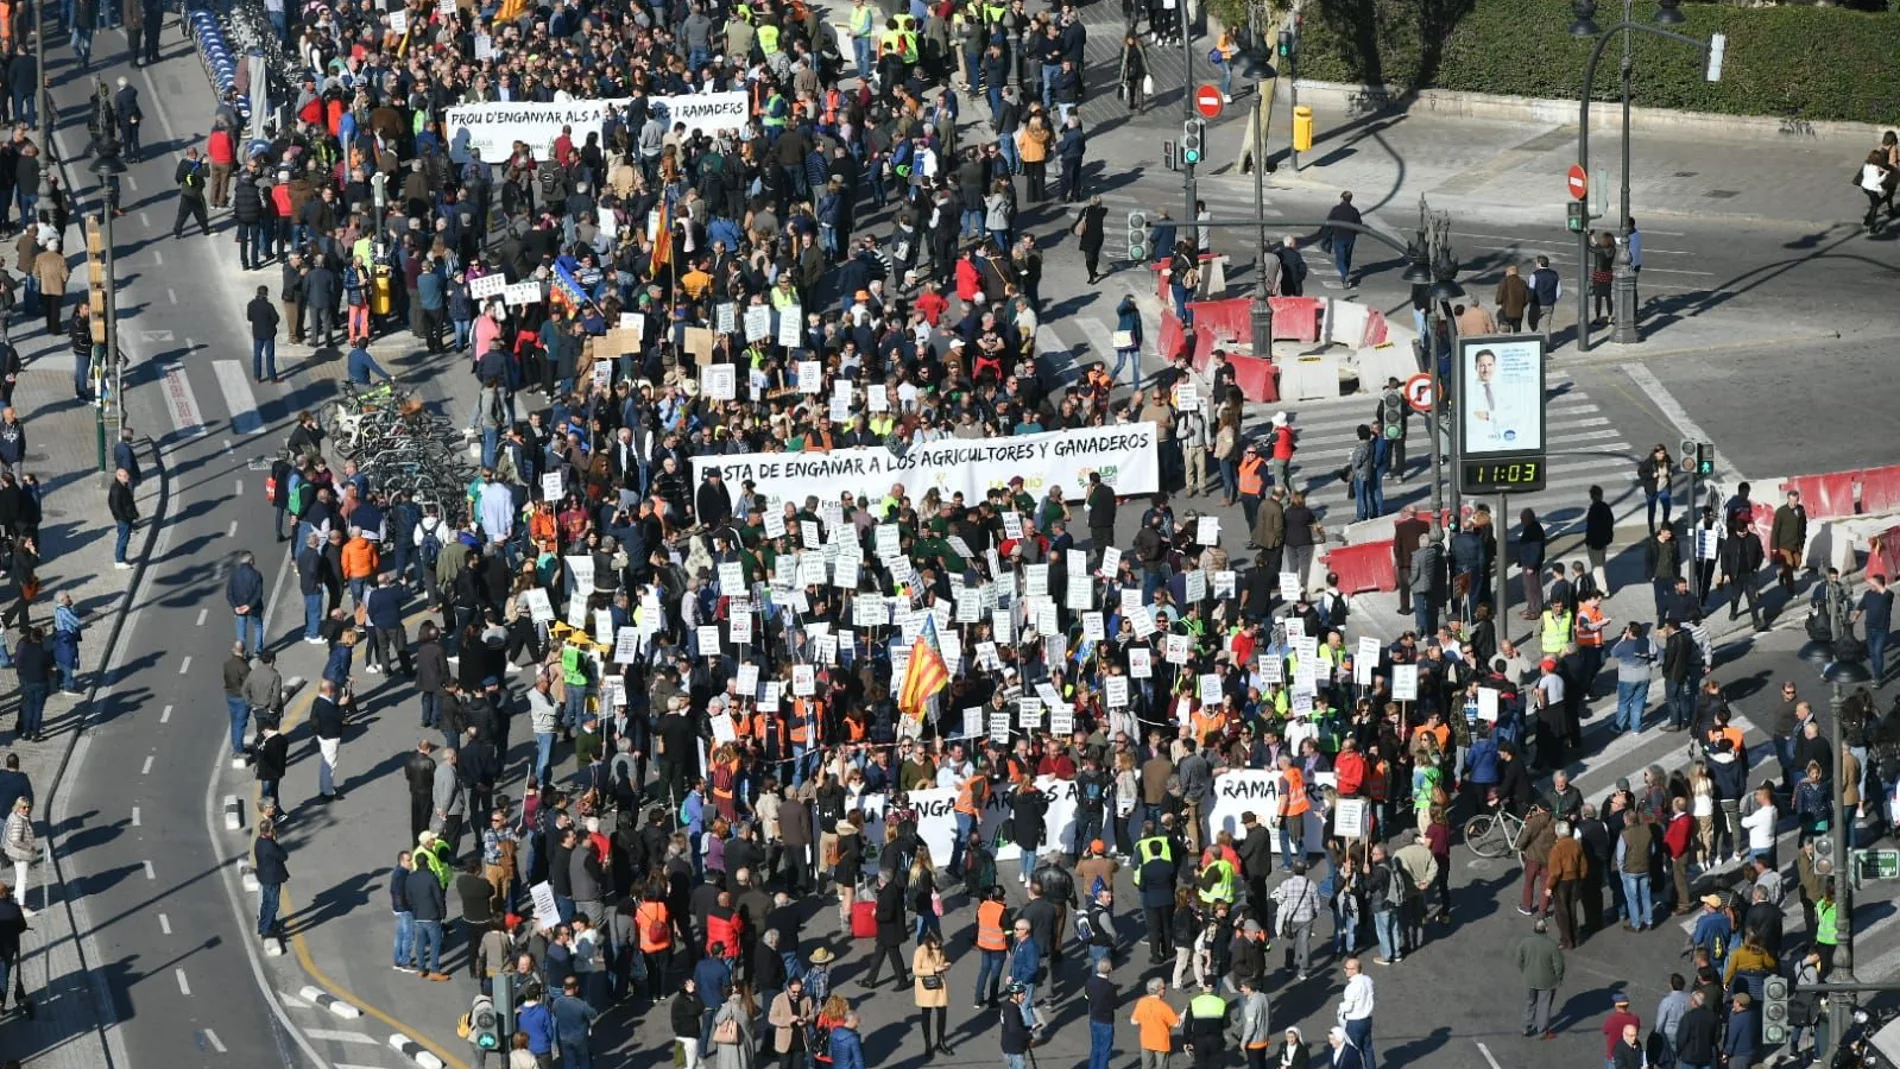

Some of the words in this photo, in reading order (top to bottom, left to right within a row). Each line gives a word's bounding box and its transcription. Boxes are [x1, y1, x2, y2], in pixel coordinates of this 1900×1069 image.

[451, 112, 482, 126] PROU
[486, 110, 563, 124] D'ENGANYAR
[566, 109, 589, 122] ALS
[682, 102, 744, 118] RAMADERS
[759, 463, 780, 479] DE
[785, 455, 866, 478] ENGAÑAR
[869, 456, 881, 474] A
[887, 453, 916, 471] LOS
[921, 443, 1035, 468] AGRICULTORES
[1040, 441, 1050, 458] Y
[1054, 432, 1149, 457] GANADEROS
[1478, 463, 1535, 483] 11:03
